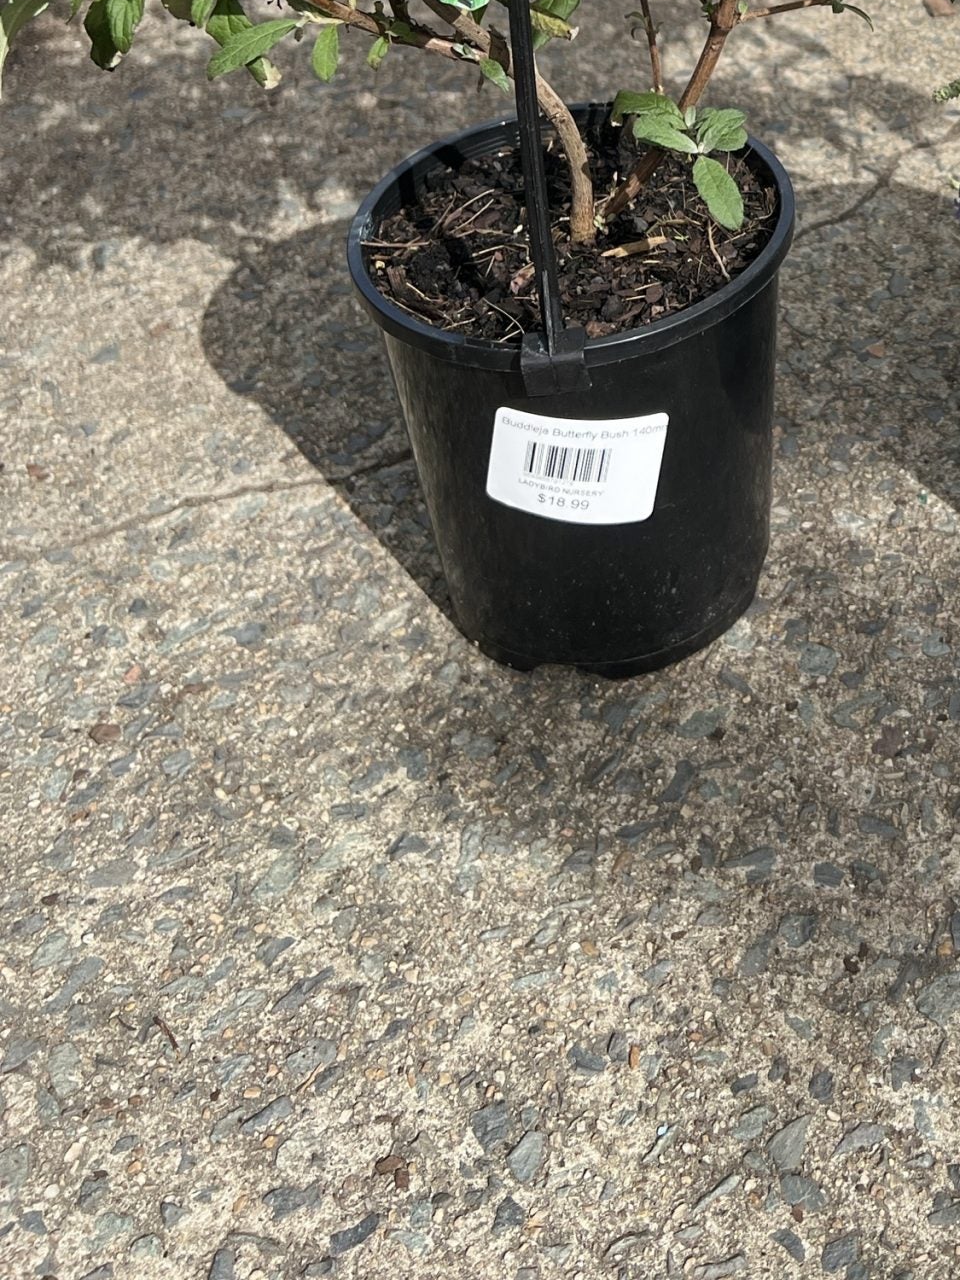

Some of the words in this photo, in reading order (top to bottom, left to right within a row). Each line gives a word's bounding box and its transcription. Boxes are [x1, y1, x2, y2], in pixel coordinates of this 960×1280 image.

[552, 428, 598, 441] Butterfly
[600, 430, 629, 439] Bush
[518, 477, 561, 493] LADYBIRD
[562, 488, 605, 497] NURSERY
[537, 493, 590, 511] $18.99
